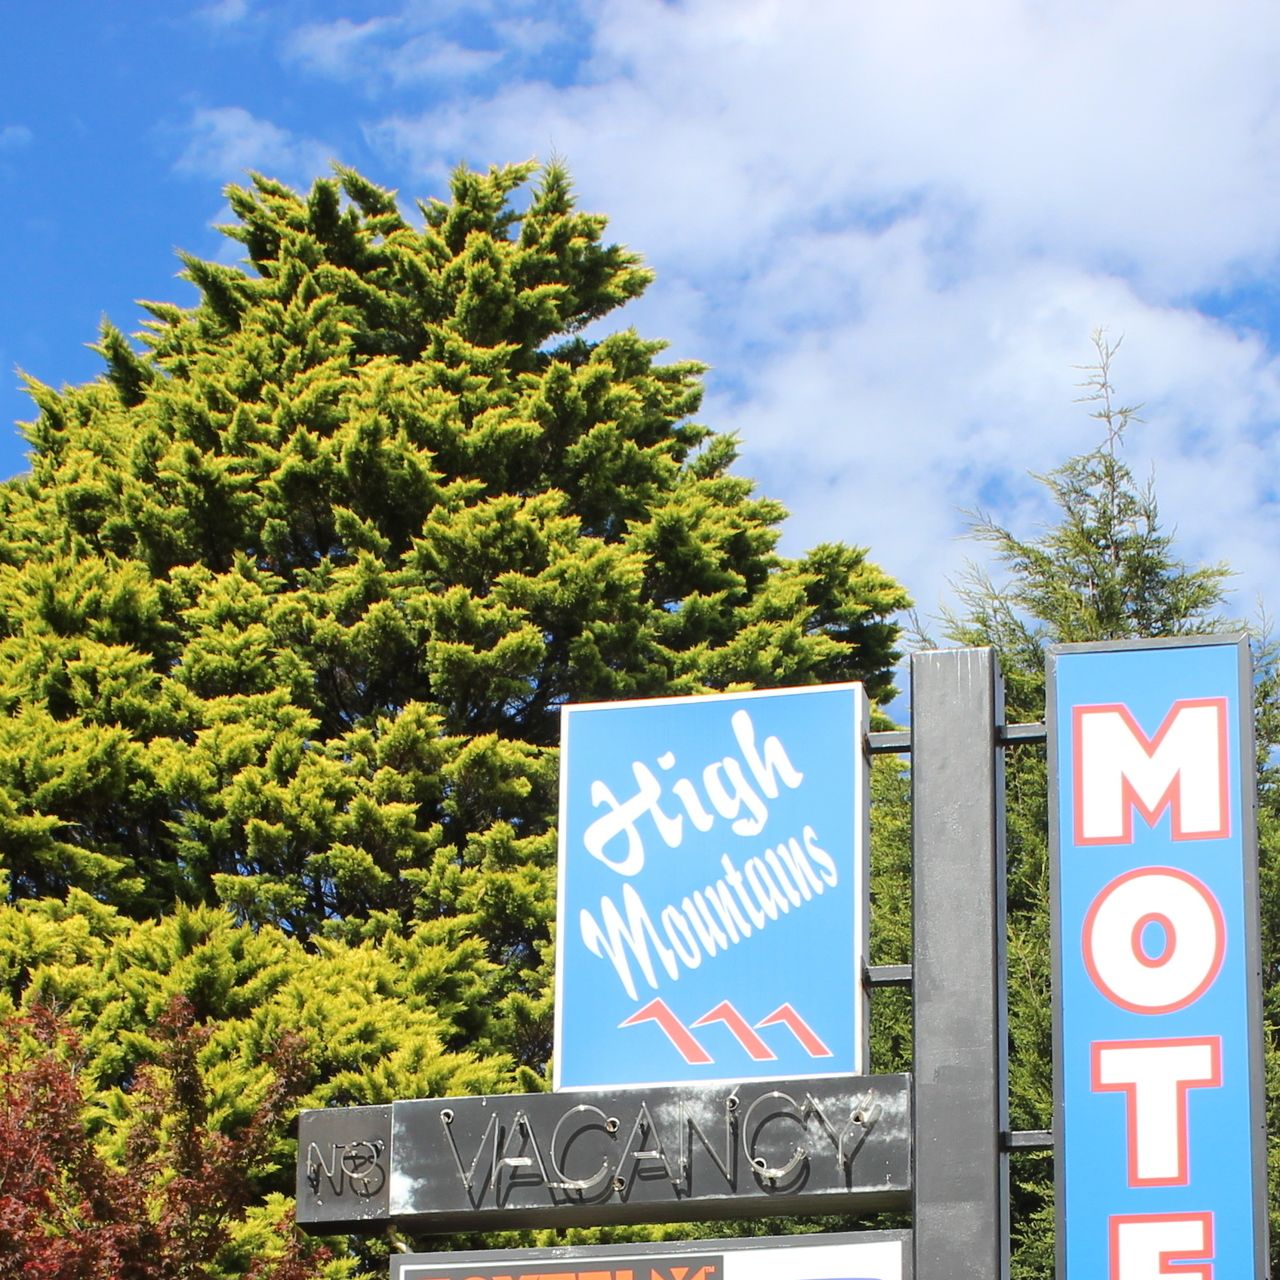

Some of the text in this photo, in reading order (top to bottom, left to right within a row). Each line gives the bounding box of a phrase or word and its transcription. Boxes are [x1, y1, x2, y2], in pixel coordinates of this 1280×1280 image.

[582, 708, 804, 877] High
[579, 824, 839, 1002] Mountains
[439, 1088, 878, 1191] VACANCY
